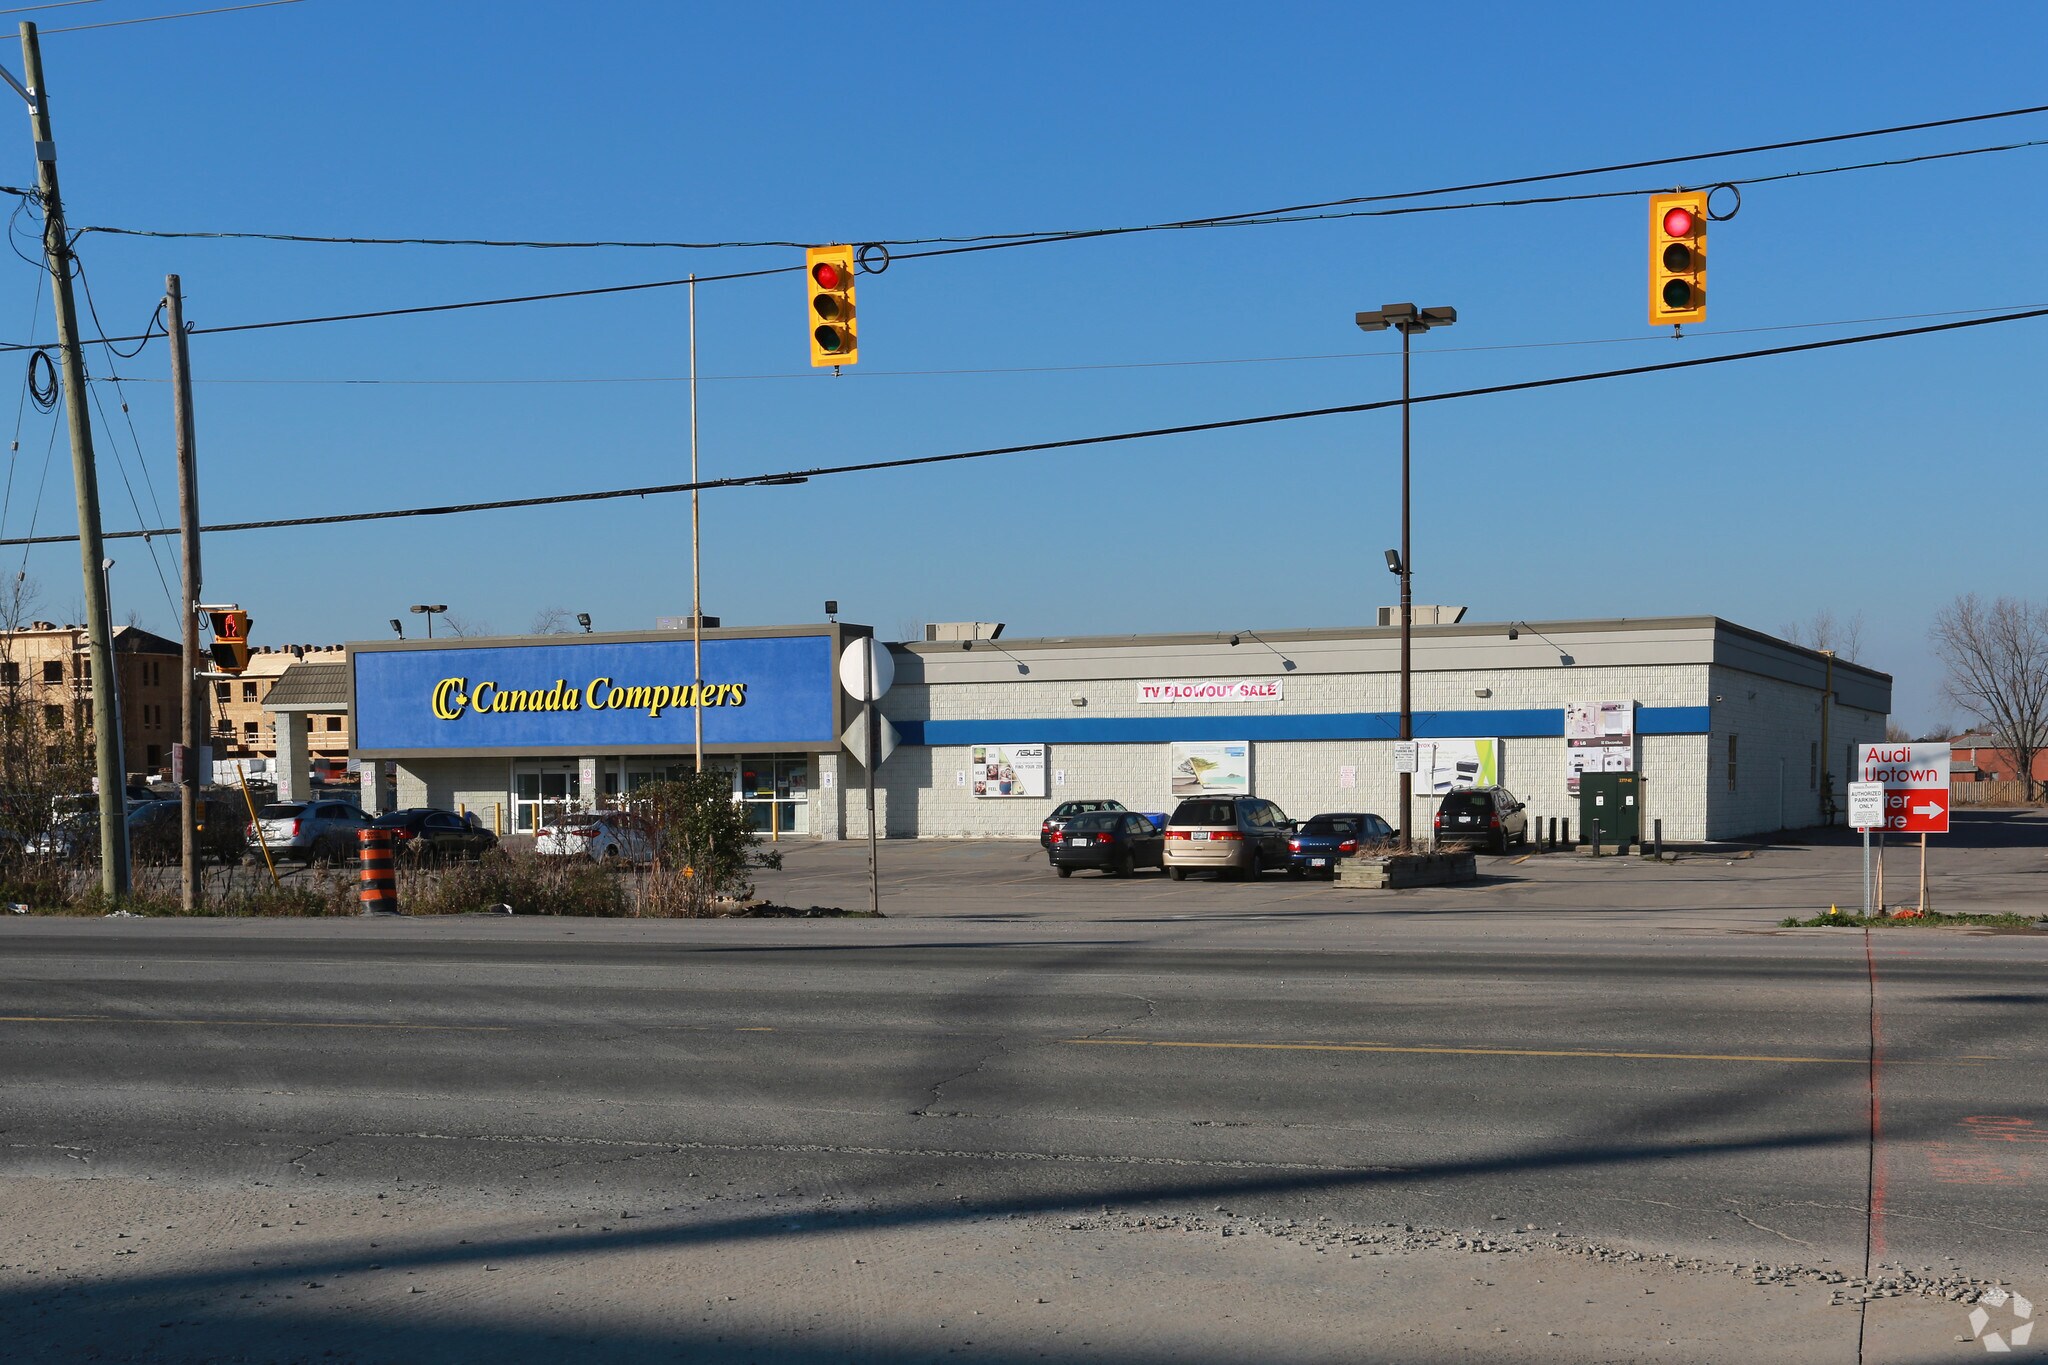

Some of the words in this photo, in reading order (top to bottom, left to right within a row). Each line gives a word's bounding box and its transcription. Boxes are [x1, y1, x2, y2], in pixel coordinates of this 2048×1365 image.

[471, 680, 580, 713] Canada
[585, 677, 746, 717] Computers
[1142, 686, 1160, 698] TV
[1164, 685, 1235, 698] BLOWOUT
[1240, 684, 1277, 697] SALE
[1016, 749, 1043, 757] ASUS
[1866, 747, 1911, 763] Audi
[1865, 767, 1938, 782] Uptown
[1884, 792, 1910, 808] ter
